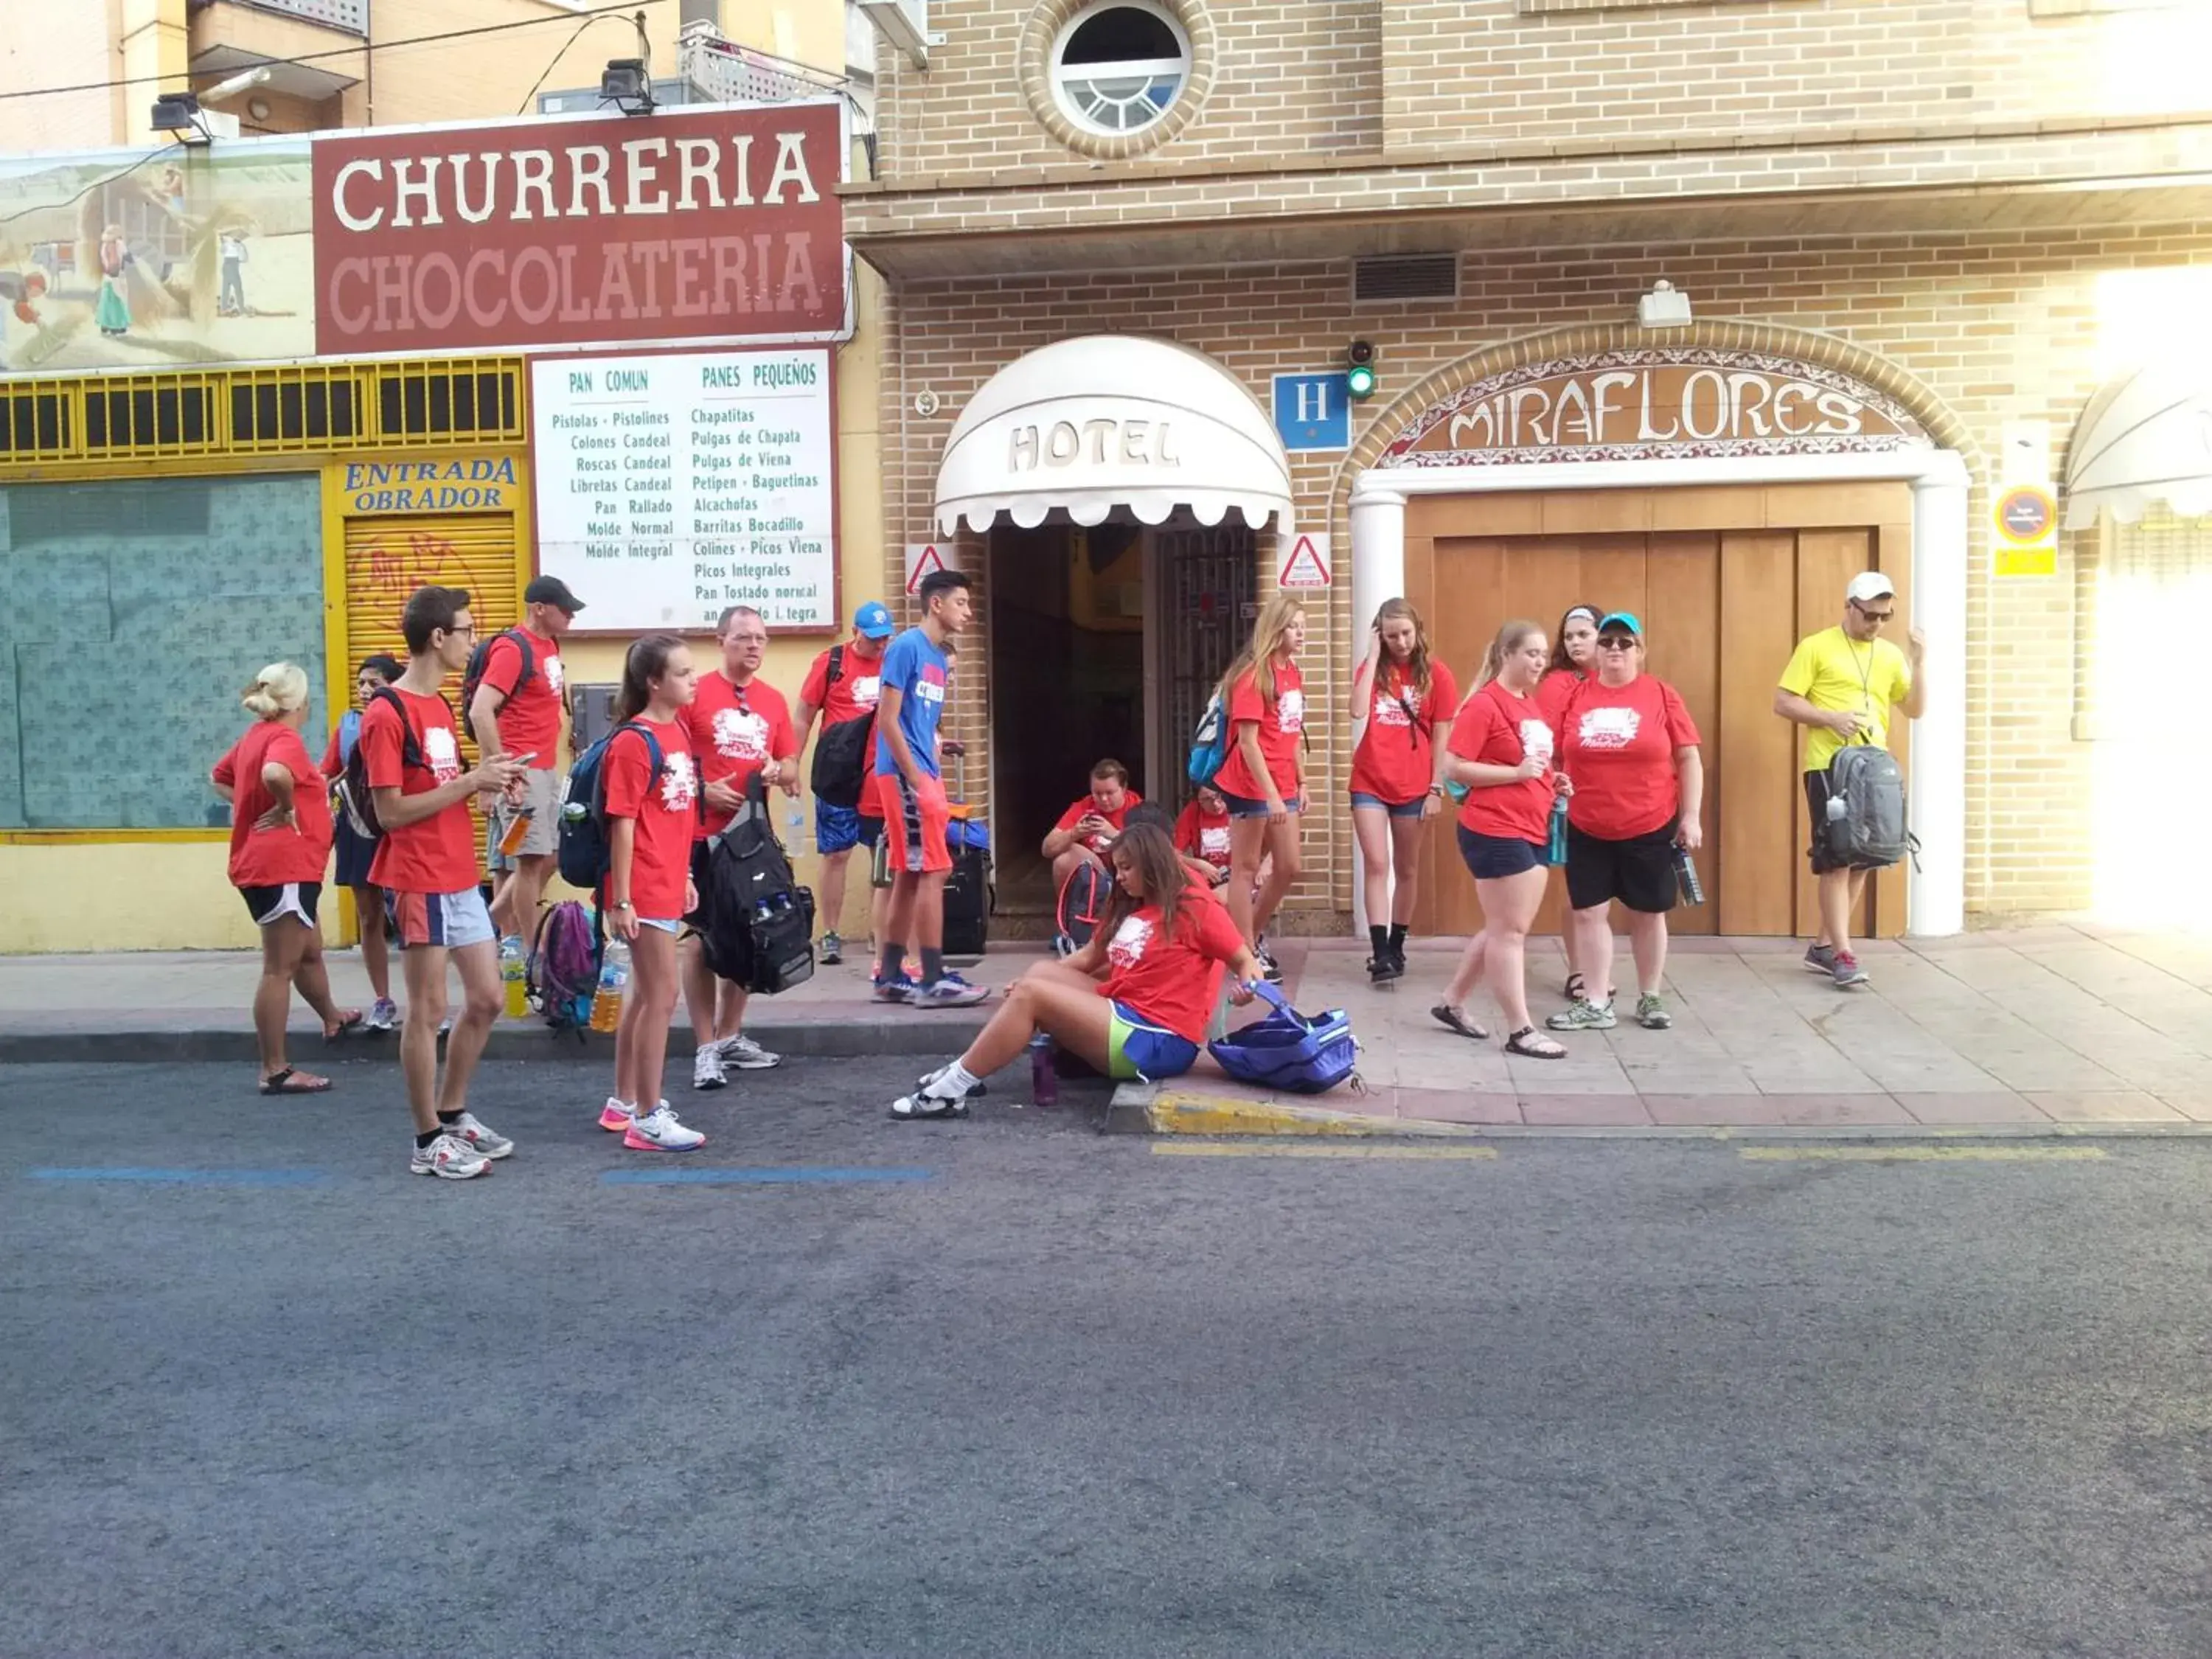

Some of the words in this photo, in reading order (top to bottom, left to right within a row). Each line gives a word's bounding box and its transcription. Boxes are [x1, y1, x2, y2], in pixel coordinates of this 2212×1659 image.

[333, 132, 819, 232] CHURRERIA
[330, 232, 821, 334] CHOCOLATERIA
[568, 372, 592, 393] PAN
[605, 370, 648, 392] COMUN
[702, 365, 741, 389] PANES
[753, 358, 816, 390] PEQUEÑOS
[1295, 382, 1329, 422] H
[1450, 370, 1863, 448] MIRAFLORES
[613, 411, 669, 426] Pistolines
[691, 408, 754, 426] Chapatitas
[571, 435, 616, 450] Colones
[623, 434, 670, 448] Candeal
[691, 431, 731, 449] Pulgas
[737, 431, 751, 445] de
[1008, 419, 1180, 473] HOTEL
[577, 457, 617, 472] Roscas
[624, 455, 671, 470] Candeal
[692, 453, 732, 471] Pulgas
[738, 453, 752, 467] de
[758, 453, 791, 466] Viena
[344, 456, 517, 492] ENTRADA
[752, 473, 818, 492] Baguetinas
[625, 476, 672, 492] Candeal
[355, 487, 501, 510] OBRADOR
[595, 500, 616, 514] Pan
[629, 498, 672, 514] Rallado
[694, 496, 758, 512] Alcachofas
[587, 522, 621, 536] Molde
[631, 521, 673, 535] Normal
[694, 518, 742, 533] Barritas
[748, 517, 804, 532] Bocadillo
[585, 544, 620, 558] Molde
[627, 542, 672, 560] Integral
[692, 541, 735, 556] Colines
[751, 540, 782, 554] Picos
[789, 538, 822, 554] Viena
[694, 563, 726, 578] Picos
[732, 563, 790, 580] Integrales
[695, 585, 717, 599] Pan
[724, 584, 769, 599] Tostado
